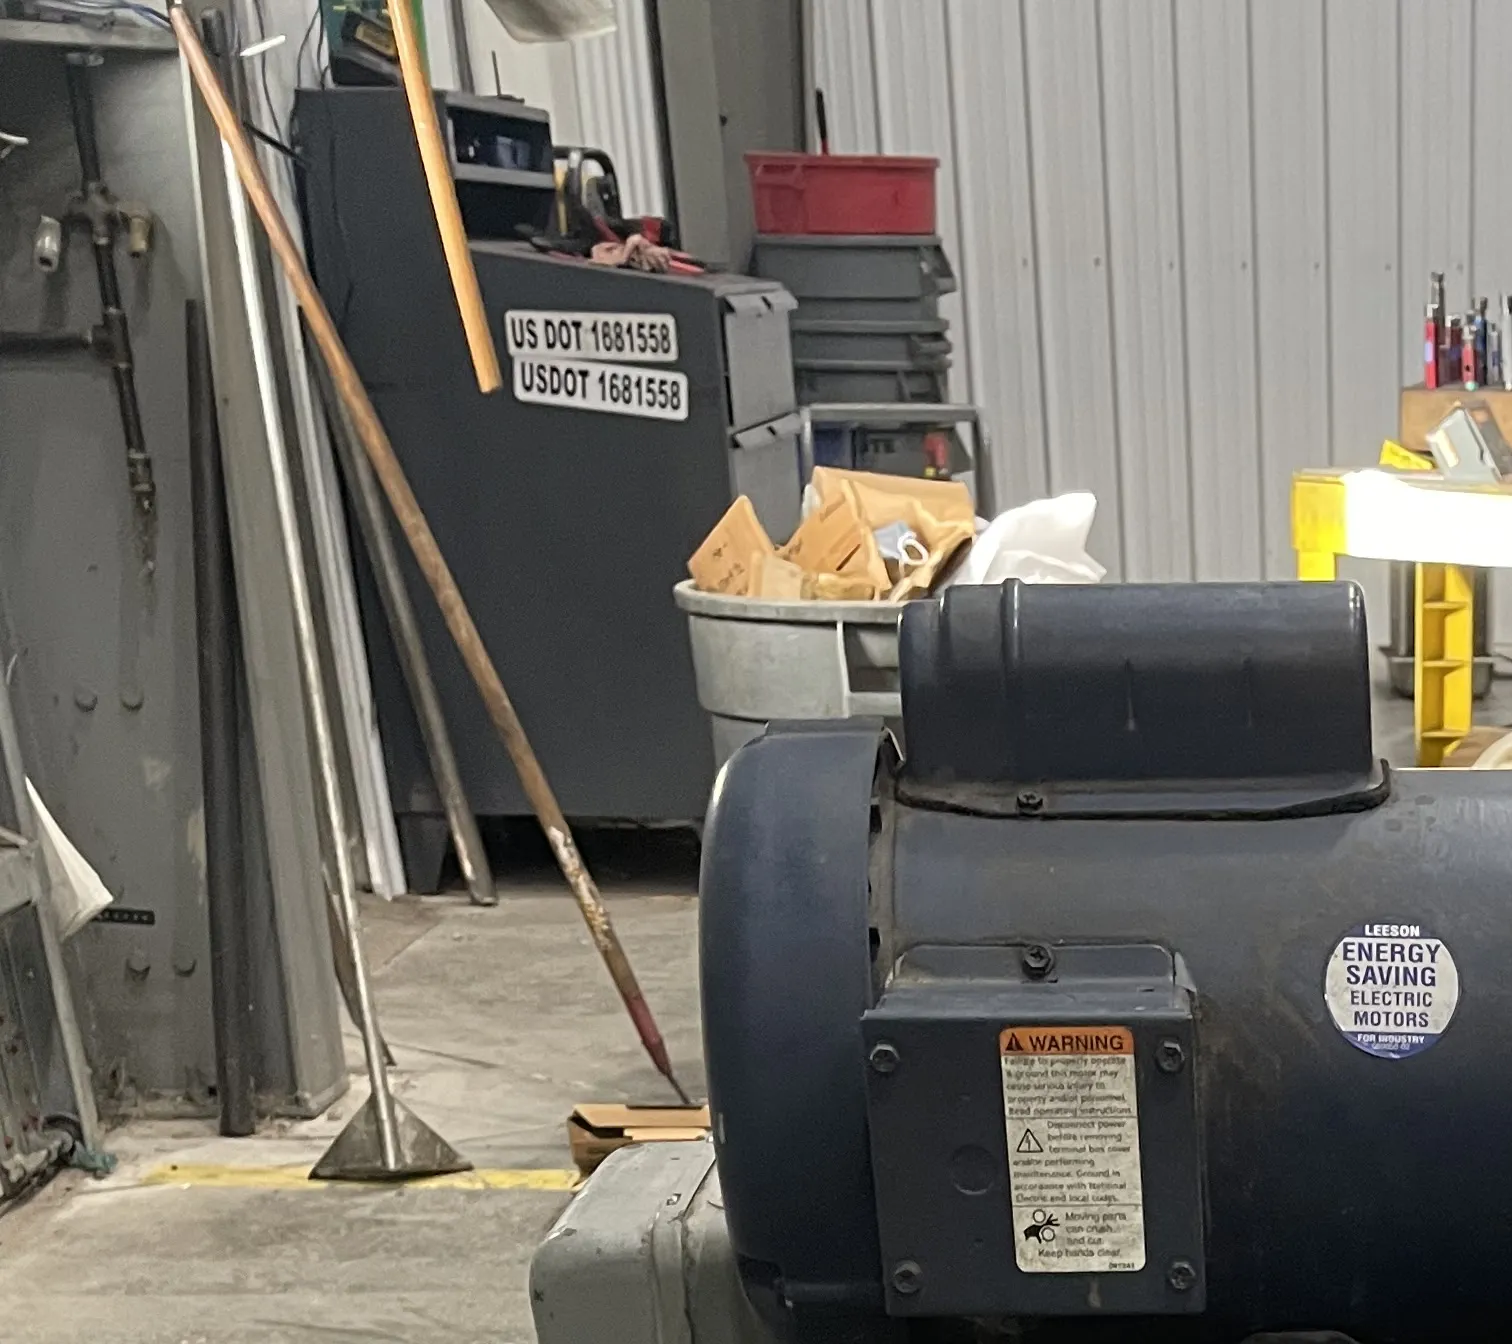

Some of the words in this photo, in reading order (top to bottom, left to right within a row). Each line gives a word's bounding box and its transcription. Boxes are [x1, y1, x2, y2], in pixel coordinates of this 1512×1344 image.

[511, 317, 538, 349] US
[545, 319, 582, 351] DOT
[591, 320, 671, 354] 1681558
[521, 361, 589, 400] USDOT
[598, 371, 681, 411] 1681558
[1364, 924, 1420, 937] LEESON
[1342, 941, 1441, 964] ENERGY
[1346, 965, 1436, 987] SAVING
[1350, 990, 1433, 1007] ELECTRIC
[1354, 1010, 1429, 1028] MOTORS
[1029, 1034, 1124, 1052] WARNING
[1357, 1033, 1376, 1043] FOR
[1378, 1034, 1425, 1044] INDUSTRY
[1065, 1211, 1100, 1223] Moving
[1102, 1212, 1127, 1222] parts
[1065, 1225, 1084, 1234] can
[1086, 1224, 1113, 1234] crush
[1066, 1236, 1085, 1245] and
[1038, 1248, 1063, 1259] Keep
[1064, 1248, 1095, 1258] hands
